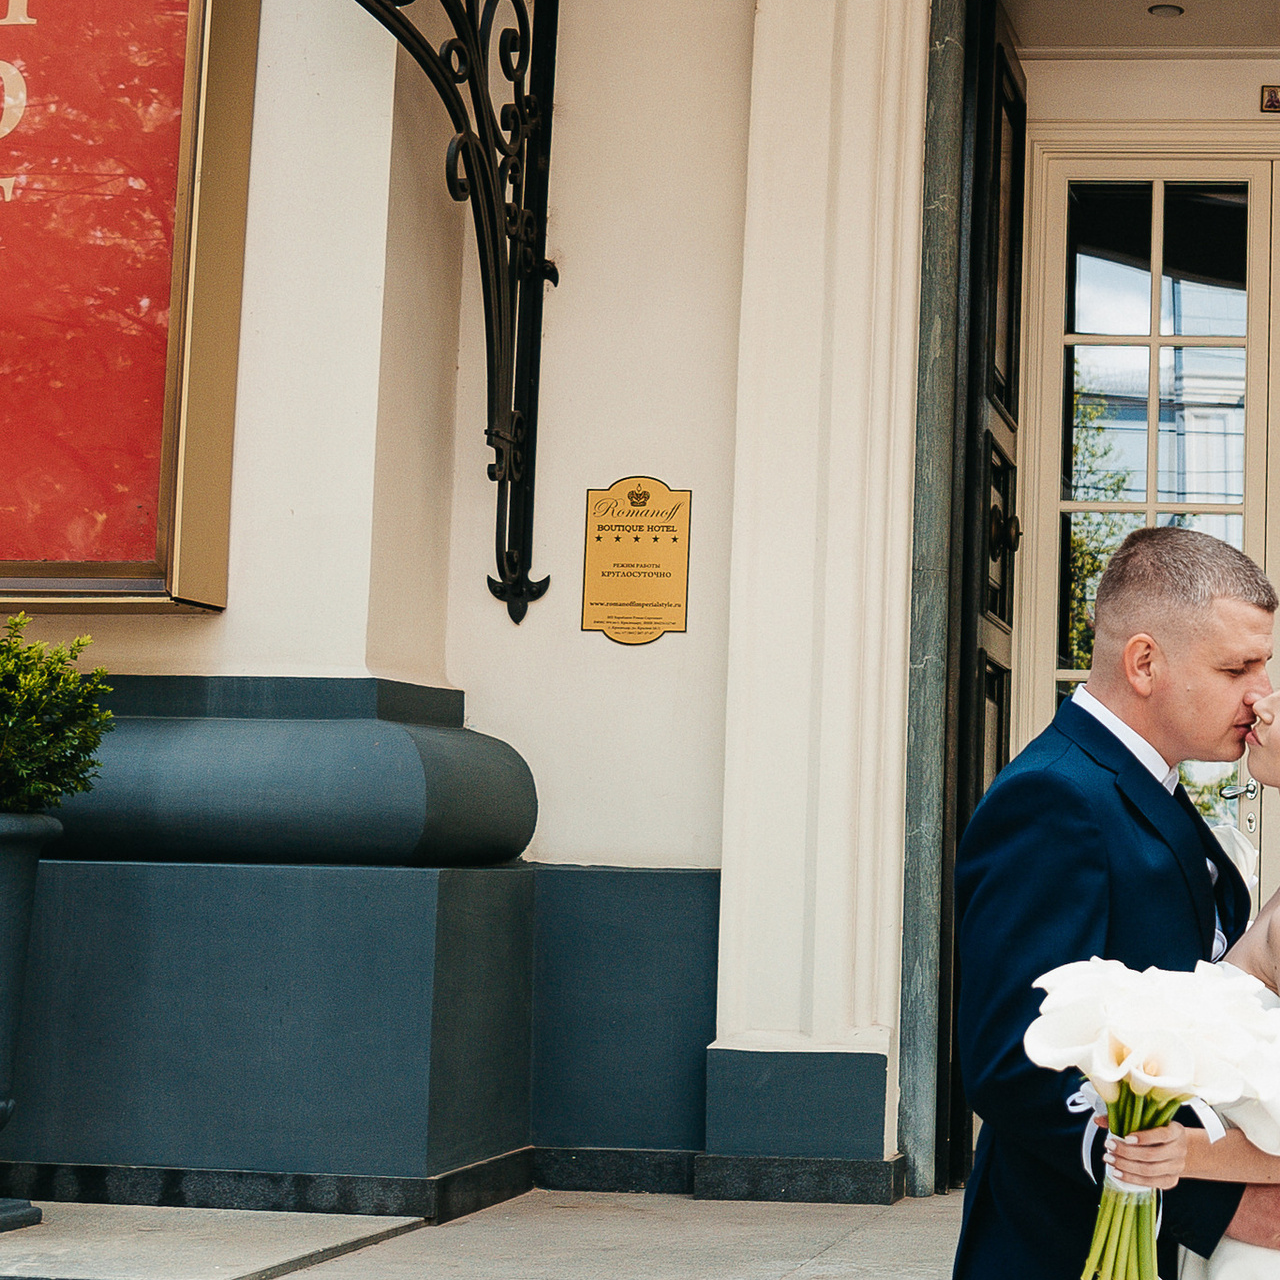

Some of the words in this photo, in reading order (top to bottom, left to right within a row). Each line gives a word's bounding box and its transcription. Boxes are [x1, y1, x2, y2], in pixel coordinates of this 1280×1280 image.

[593, 497, 685, 523] Romanoff
[597, 524, 644, 533] BOUTIQUE
[646, 525, 678, 533] HOTEL
[601, 571, 672, 579] КРУГЛОСУТОЧНО
